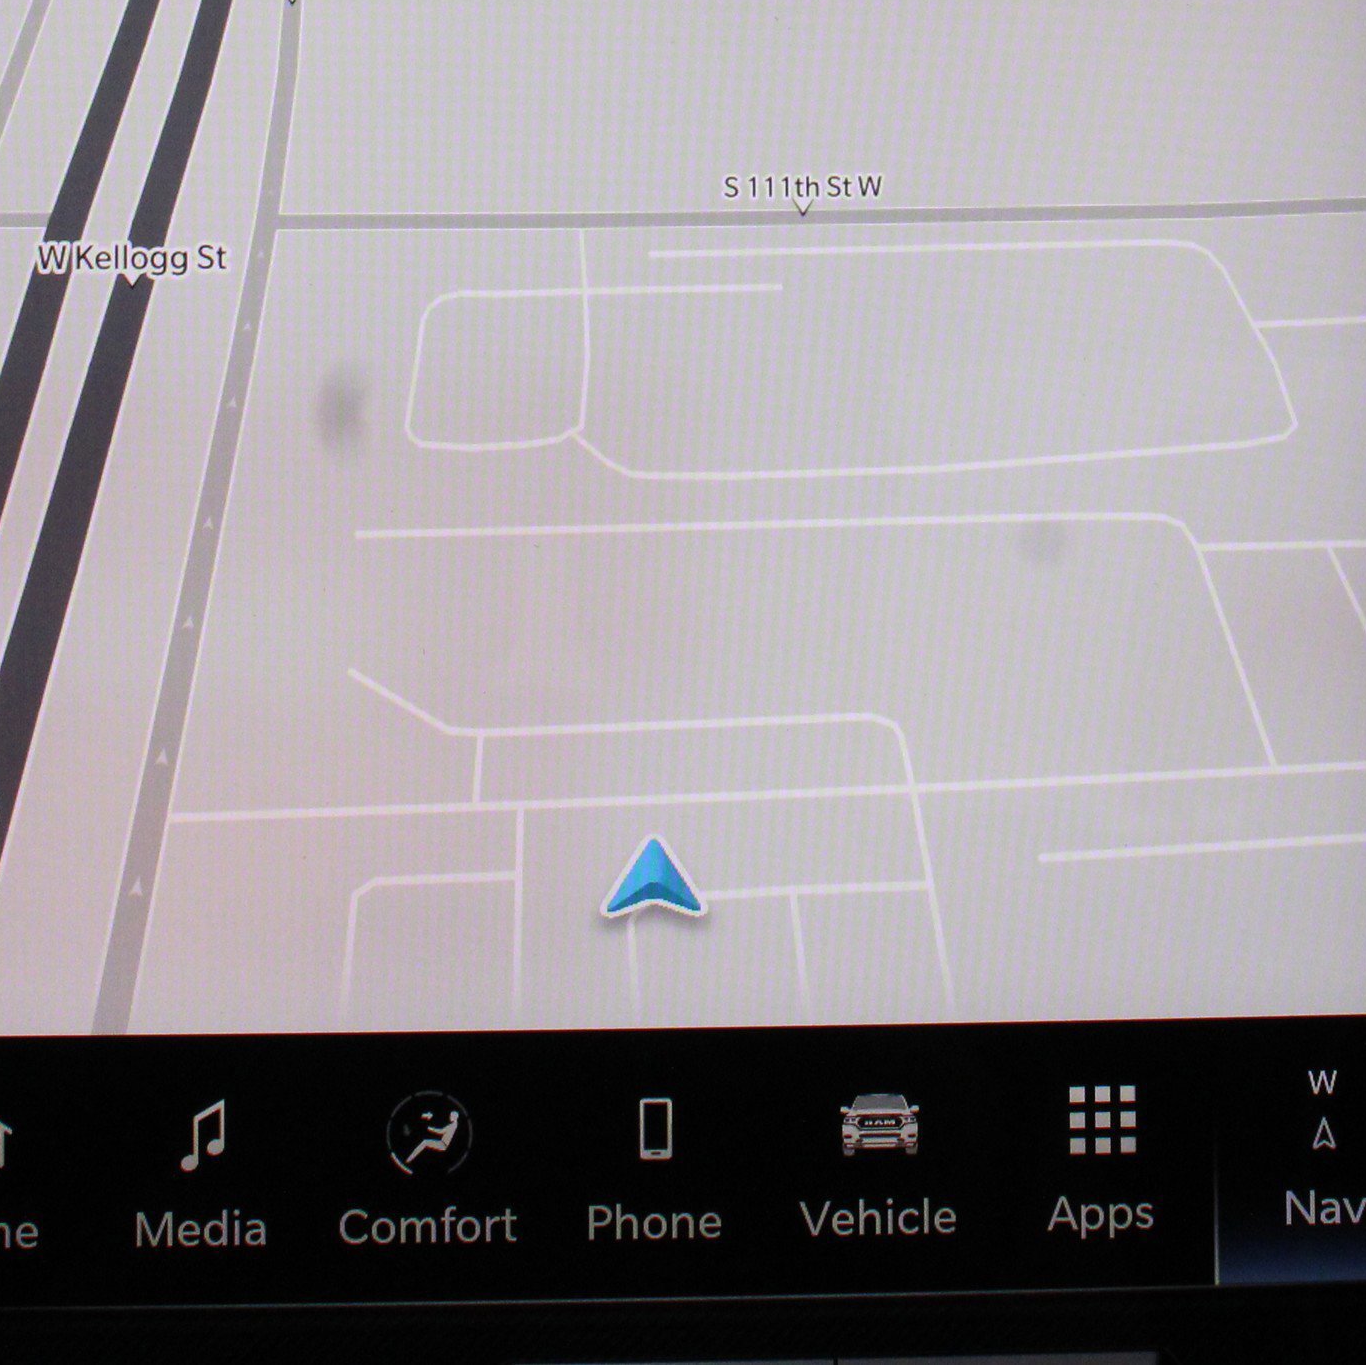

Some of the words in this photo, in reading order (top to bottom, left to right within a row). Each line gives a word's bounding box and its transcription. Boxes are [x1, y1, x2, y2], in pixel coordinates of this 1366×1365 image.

[724, 176, 739, 198] S
[749, 176, 820, 198] 111th
[827, 175, 851, 198] St
[858, 176, 882, 197] W
[37, 244, 69, 270] W
[75, 244, 189, 276] Kellogg
[196, 244, 228, 270] St
[1307, 1069, 1338, 1095] W
[136, 1209, 267, 1247] Media
[339, 1205, 518, 1245] Comfort
[588, 1203, 722, 1241] Phone
[799, 1197, 957, 1236] Vehicle
[1047, 1195, 1154, 1240] Apps
